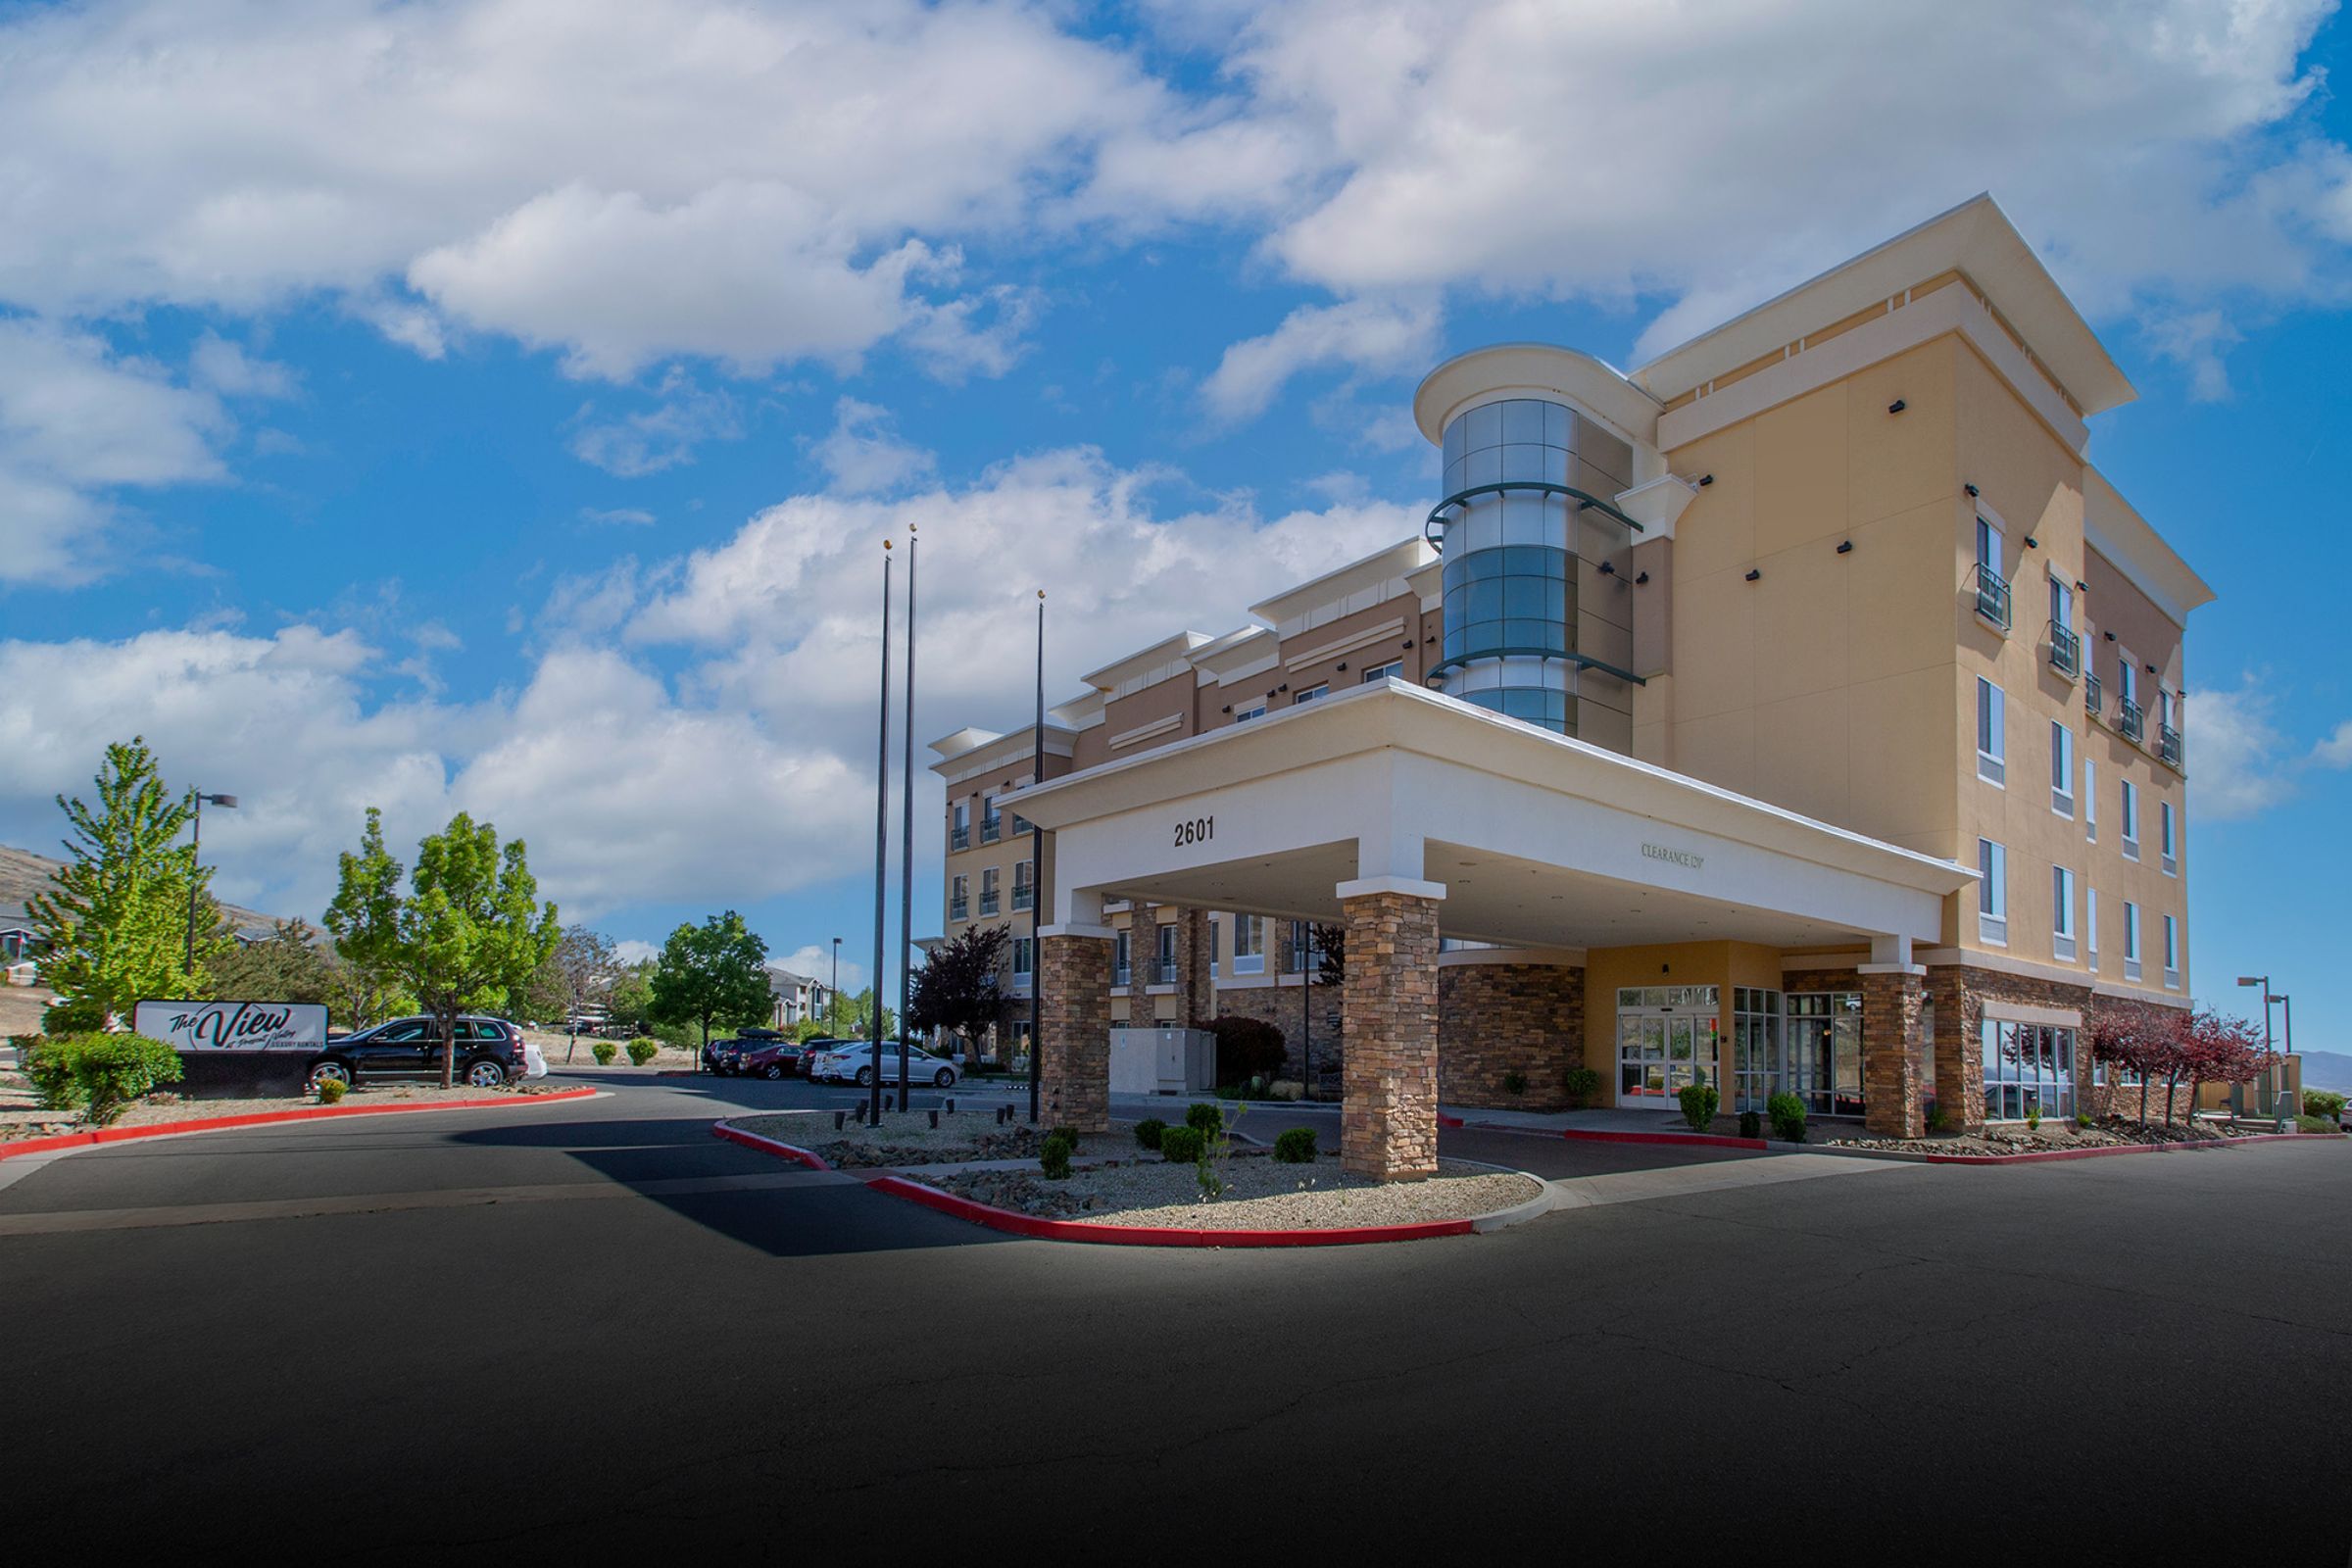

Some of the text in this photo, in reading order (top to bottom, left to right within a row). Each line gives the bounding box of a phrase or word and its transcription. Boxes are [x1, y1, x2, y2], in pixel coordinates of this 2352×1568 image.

[1174, 815, 1213, 848] 2601
[1641, 843, 1690, 865] CLEARANCE
[170, 1003, 292, 1047] The View
